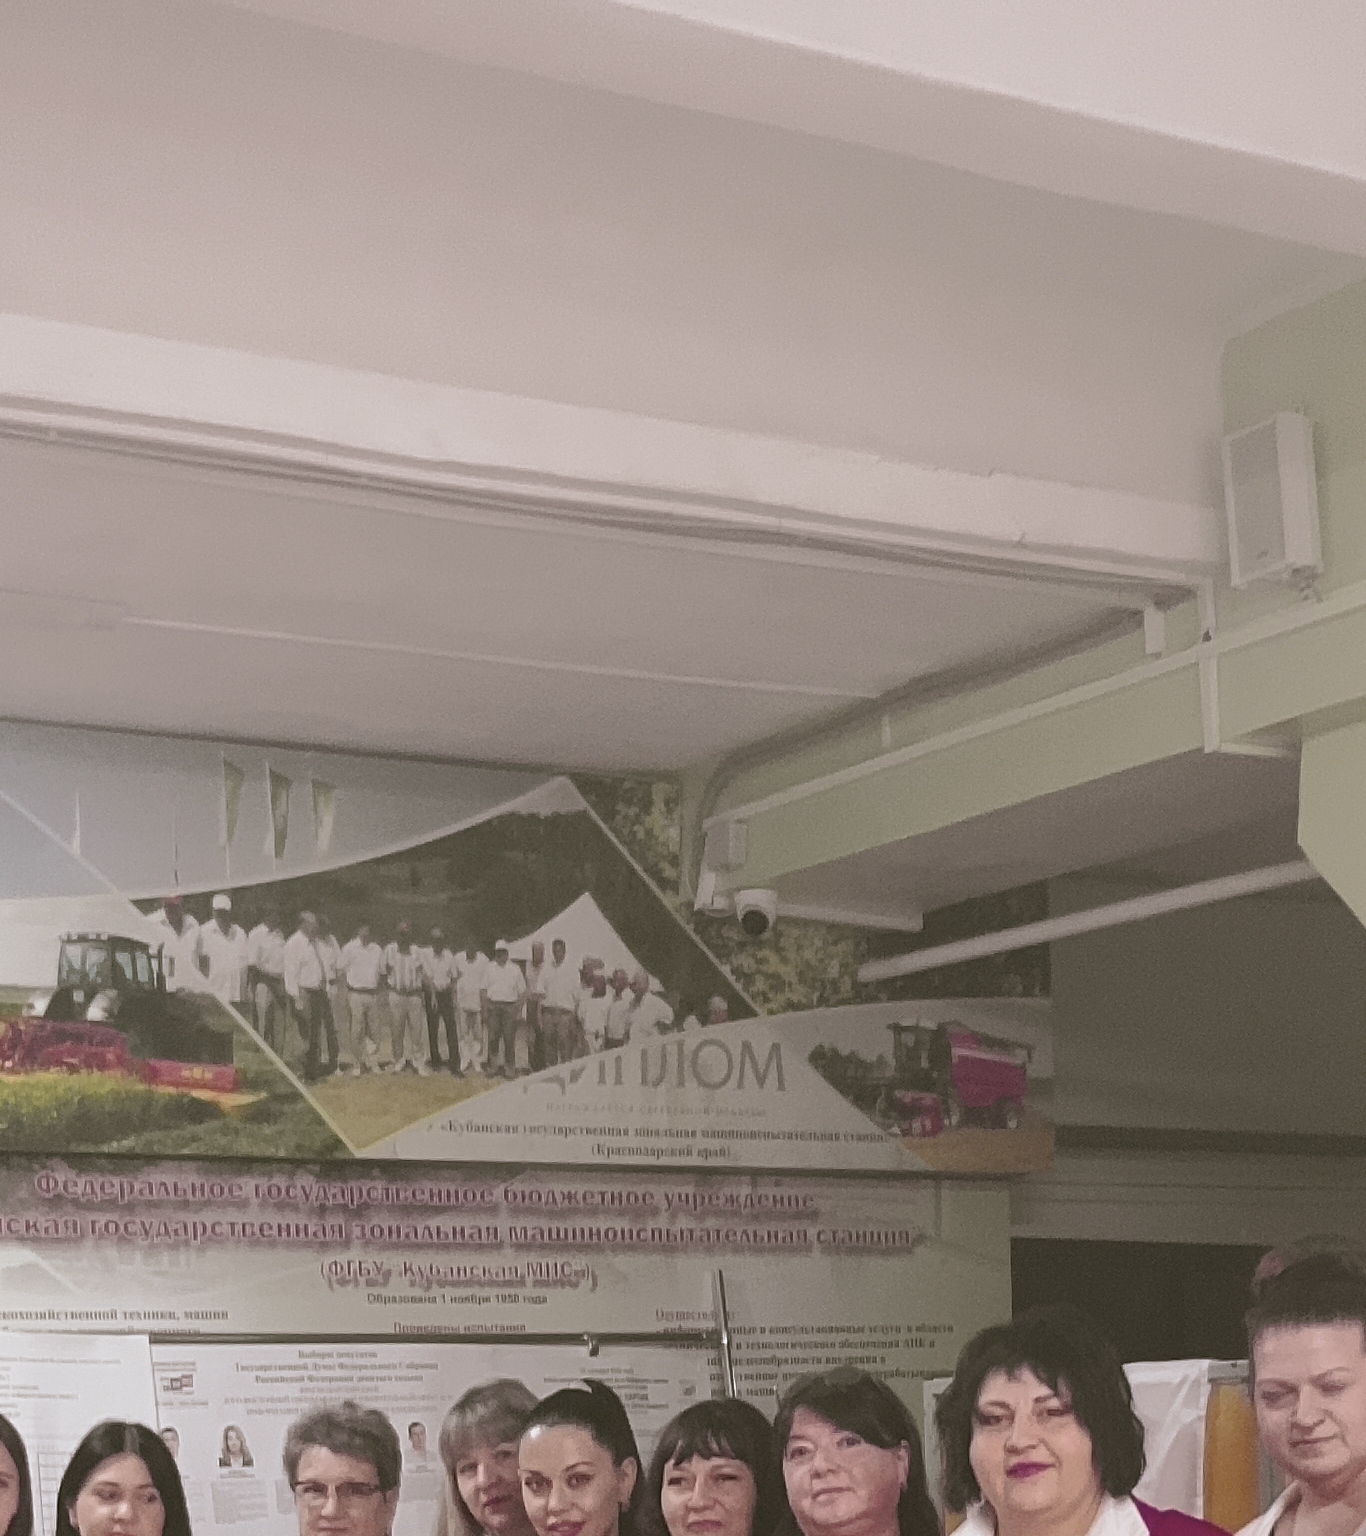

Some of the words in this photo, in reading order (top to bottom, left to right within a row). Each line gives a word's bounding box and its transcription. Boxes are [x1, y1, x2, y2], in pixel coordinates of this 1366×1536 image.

[36, 1171, 243, 1201] Федеральное
[254, 1182, 495, 1208] государственное
[503, 1186, 655, 1209] бюджетное
[664, 1190, 816, 1212] учреждение
[89, 1218, 346, 1244] государственная
[354, 1222, 500, 1244] зональная
[508, 1226, 808, 1246] машиноиспытательная
[320, 1259, 385, 1280] (ФГБУ
[450, 1293, 492, 1306] ноября
